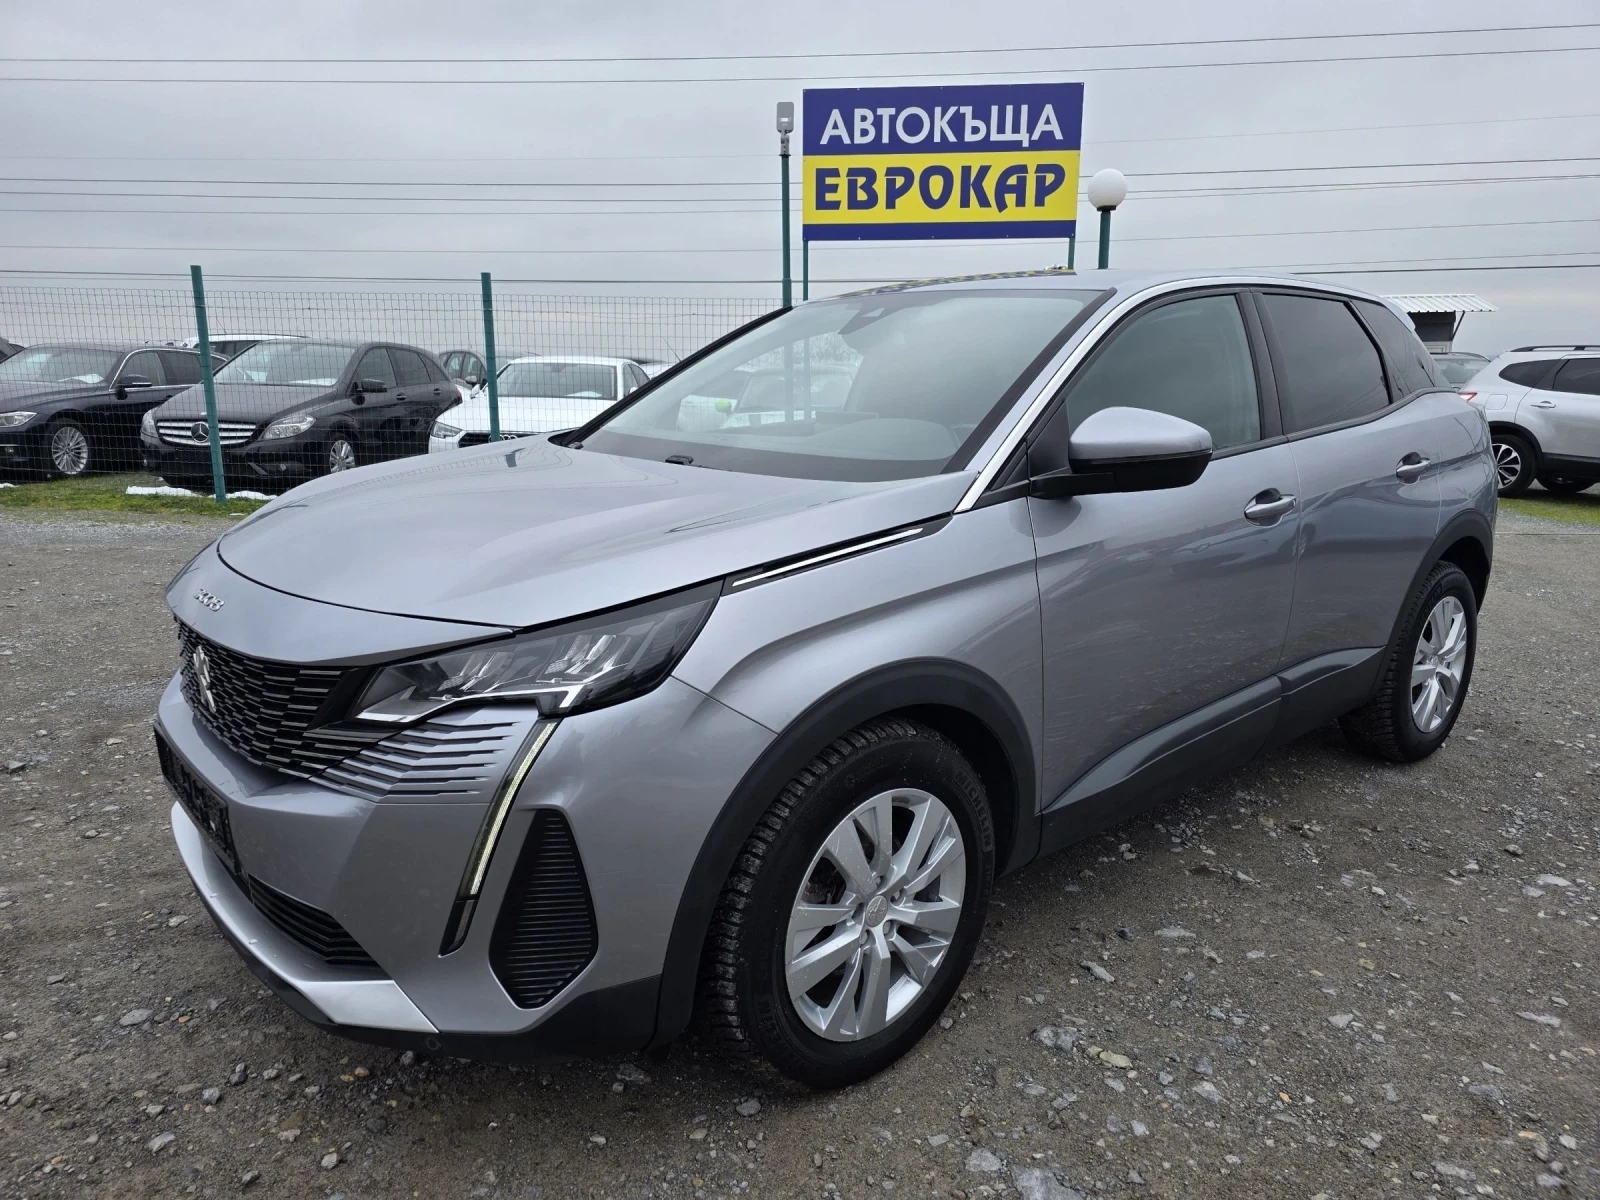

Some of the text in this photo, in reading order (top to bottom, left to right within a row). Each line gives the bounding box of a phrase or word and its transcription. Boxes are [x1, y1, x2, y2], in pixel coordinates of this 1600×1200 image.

[820, 104, 1064, 147] АВТОКЪЩА
[815, 163, 1066, 213] ЕВРОКАР
[955, 770, 993, 848] MICHELIN
